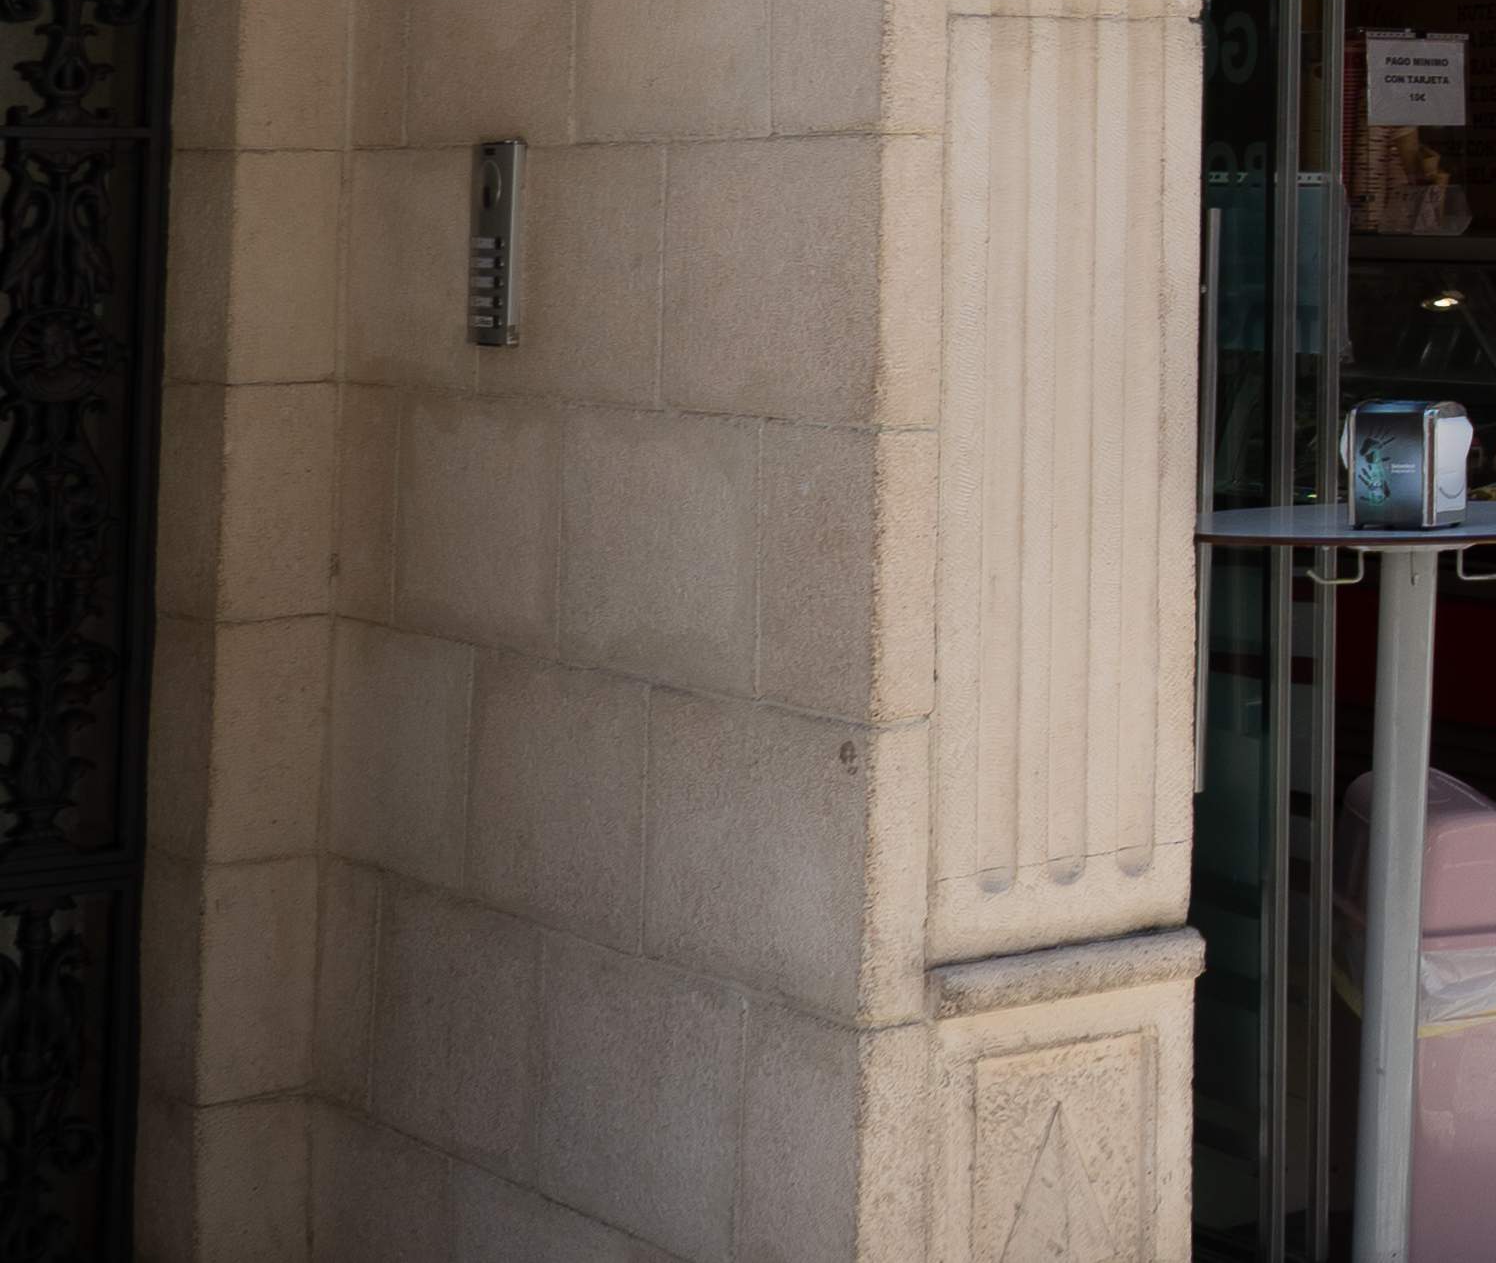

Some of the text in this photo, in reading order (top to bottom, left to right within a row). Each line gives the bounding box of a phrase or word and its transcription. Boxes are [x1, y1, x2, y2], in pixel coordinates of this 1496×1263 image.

[1385, 57, 1411, 68] PAGO
[1385, 74, 1450, 85] CON TARJETA
